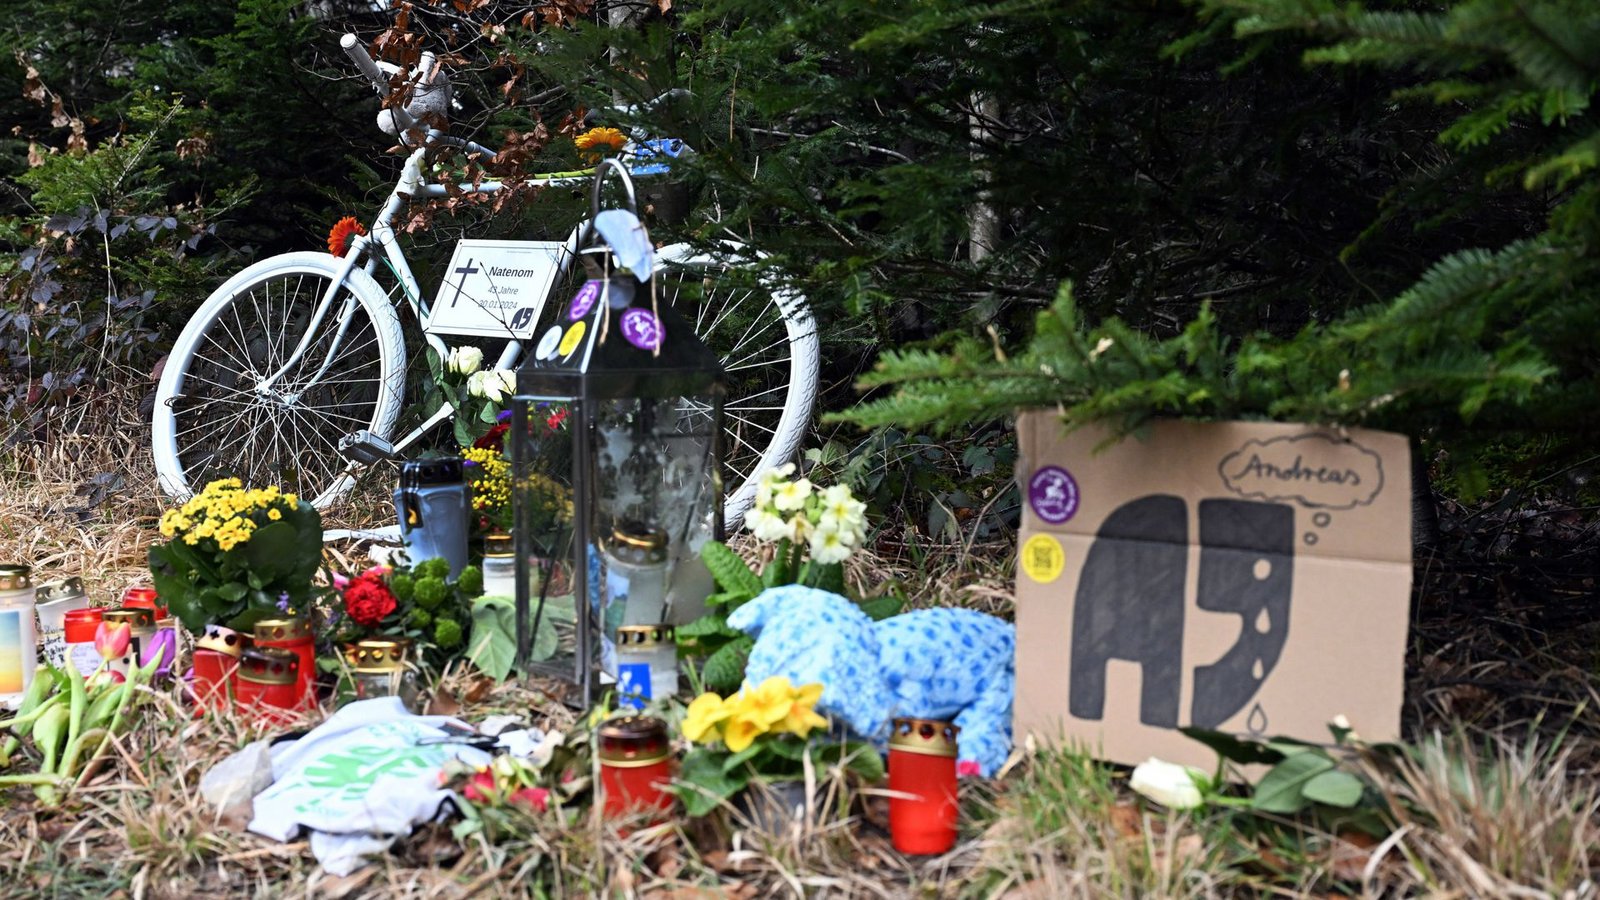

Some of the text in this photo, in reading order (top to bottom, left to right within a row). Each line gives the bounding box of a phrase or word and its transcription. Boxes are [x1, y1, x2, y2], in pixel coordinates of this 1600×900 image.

[489, 266, 534, 279] Natenom
[488, 286, 519, 295] 43 Jahre
[478, 299, 518, 309] 30.01.2024
[1231, 453, 1360, 486] Andreas
